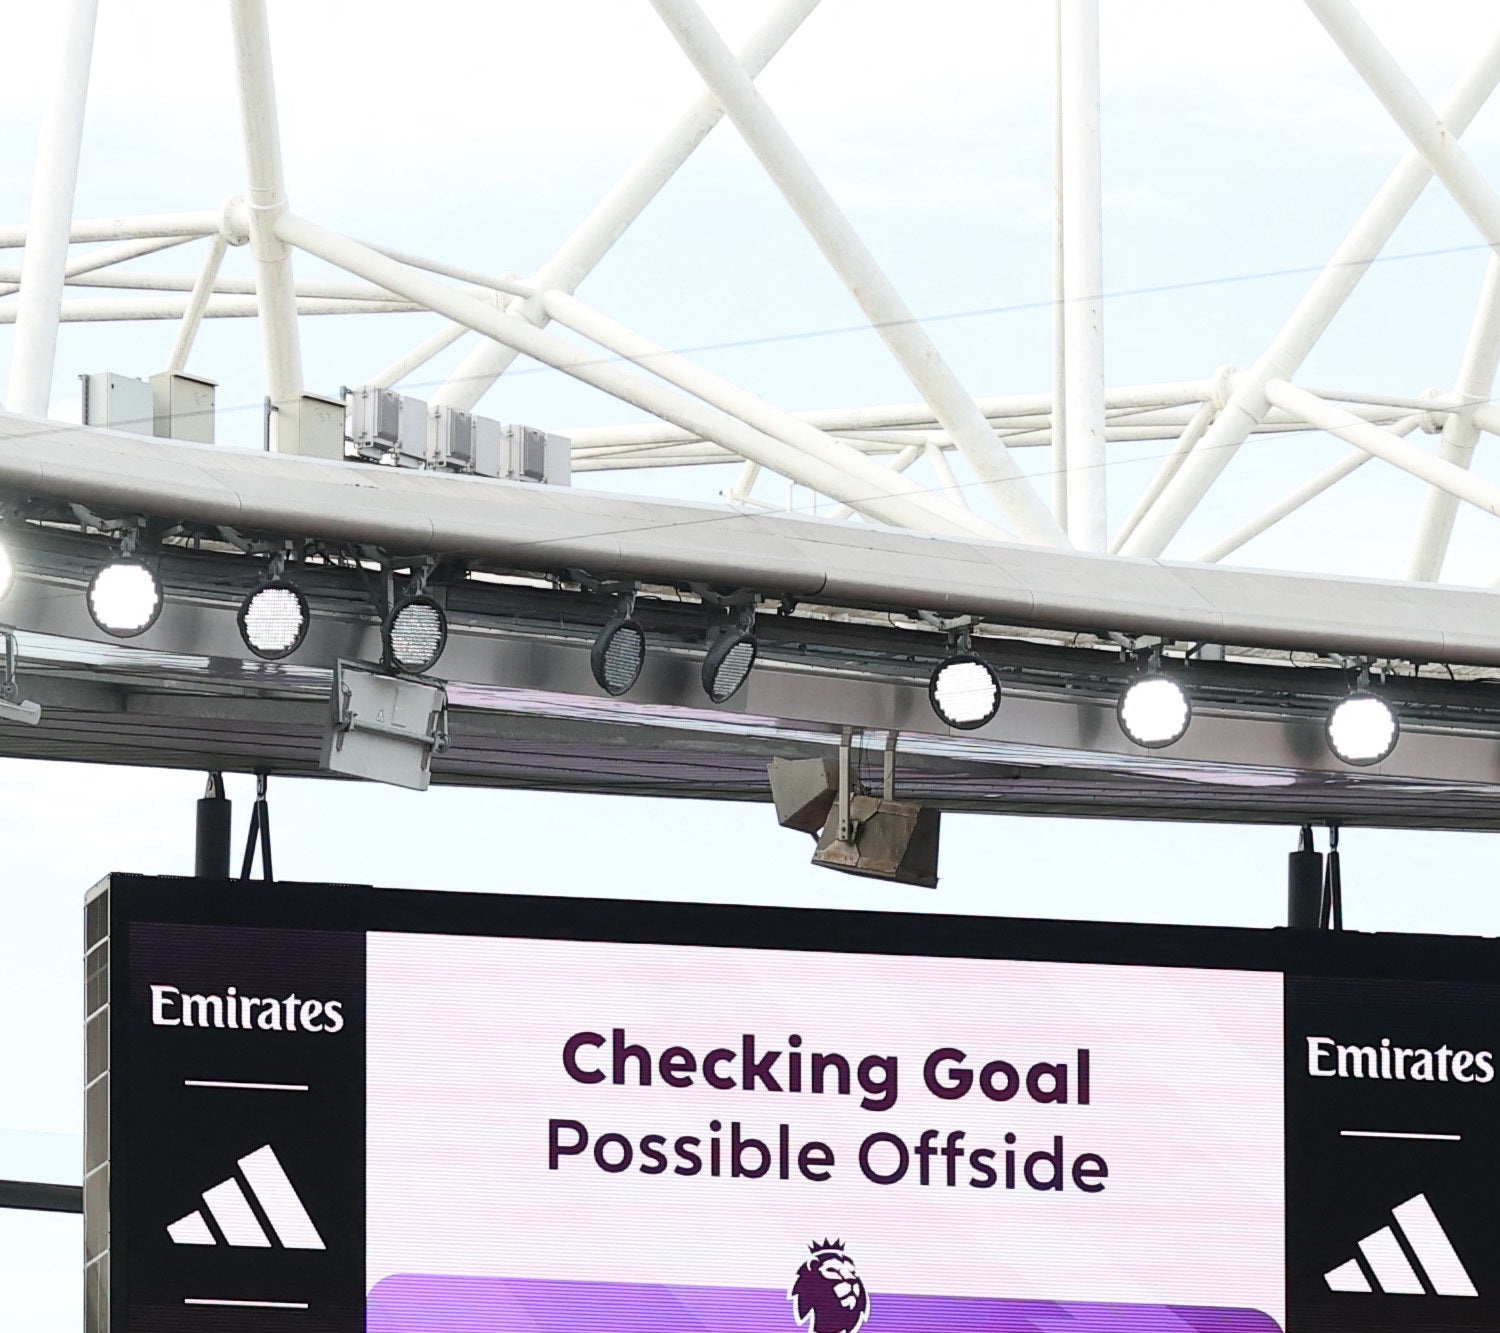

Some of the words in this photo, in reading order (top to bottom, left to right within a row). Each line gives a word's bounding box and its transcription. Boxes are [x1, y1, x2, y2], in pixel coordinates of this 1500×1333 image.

[150, 984, 344, 1035] Emirates
[562, 1029, 899, 1112] Checking
[923, 1046, 1092, 1107] Goal
[1308, 1034, 1495, 1085] Emirates
[548, 1118, 836, 1183] Possible
[859, 1131, 1109, 1195] Offside
